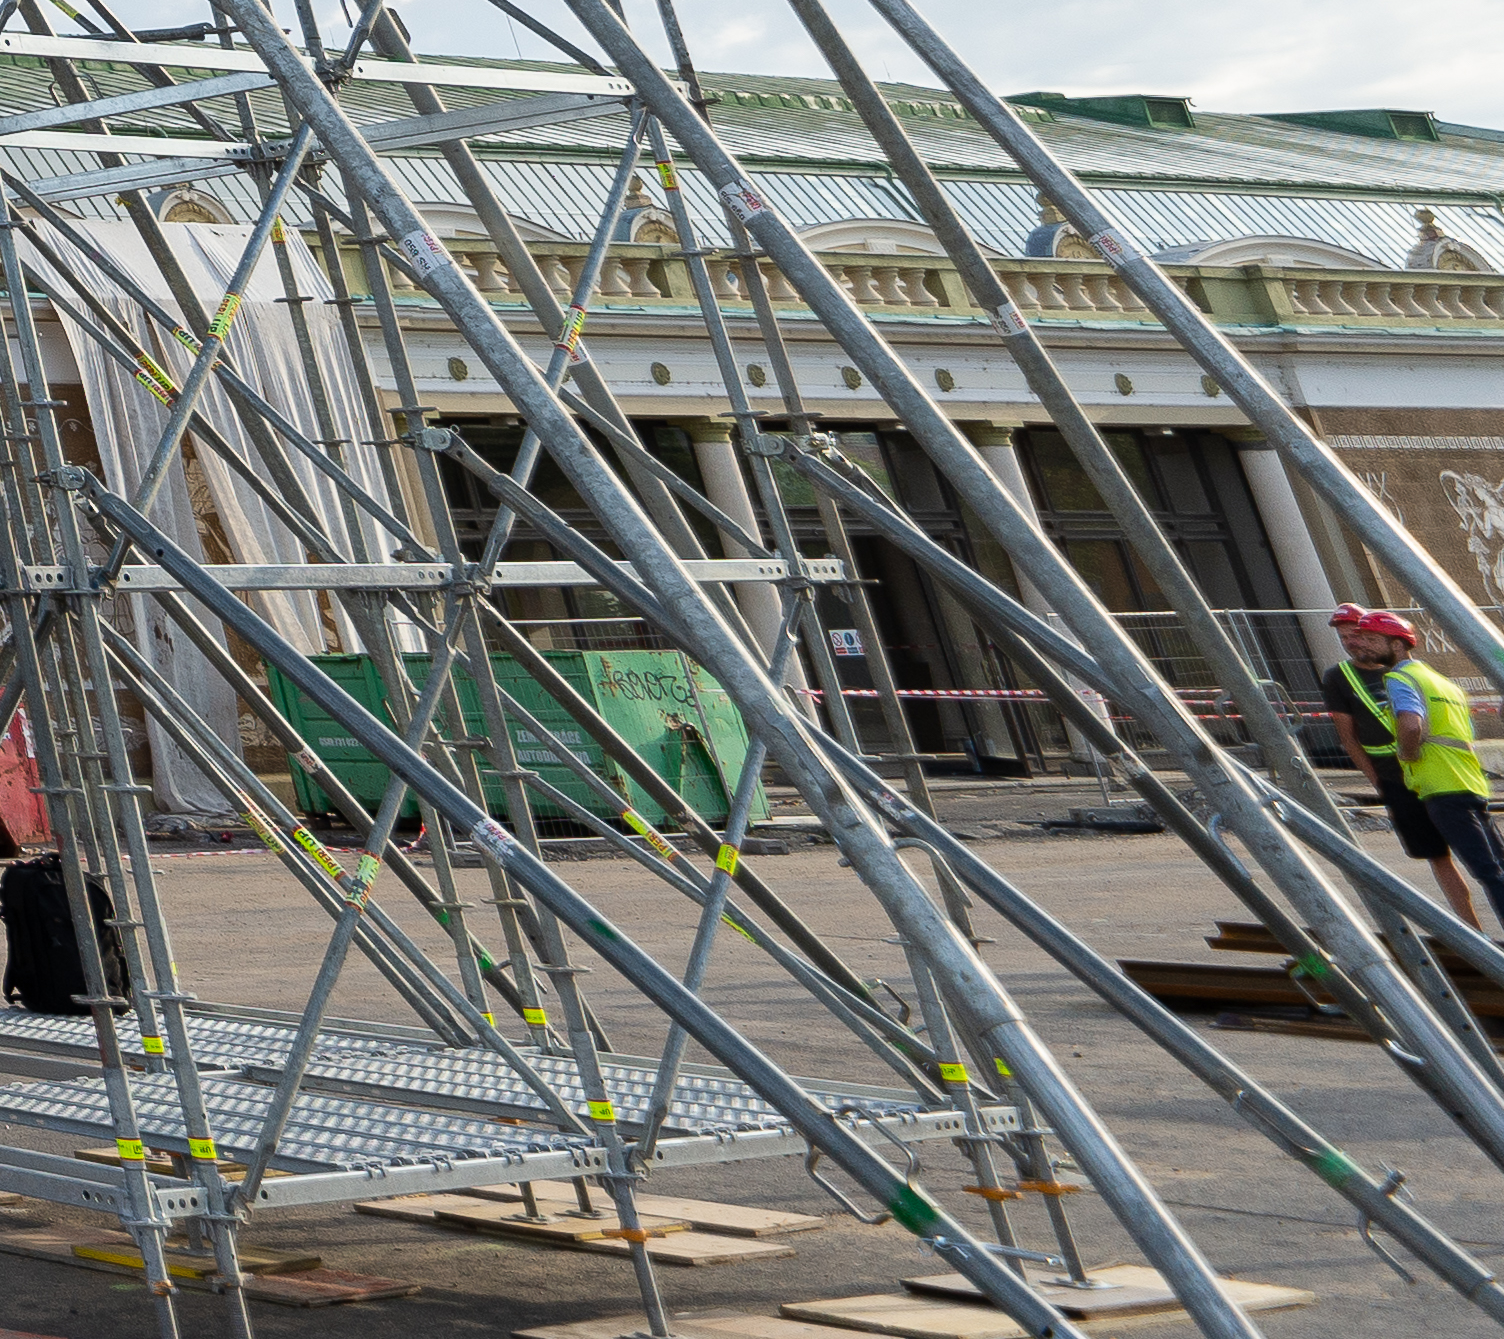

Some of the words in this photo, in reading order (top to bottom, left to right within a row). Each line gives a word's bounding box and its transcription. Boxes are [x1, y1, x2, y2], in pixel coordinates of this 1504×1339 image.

[1099, 236, 1117, 254] PERI
[178, 329, 194, 343] UP
[140, 358, 158, 377] PERI
[139, 372, 153, 384] UP
[298, 830, 315, 847] UP
[647, 831, 668, 853] PERI
[317, 848, 337, 869] PERI
